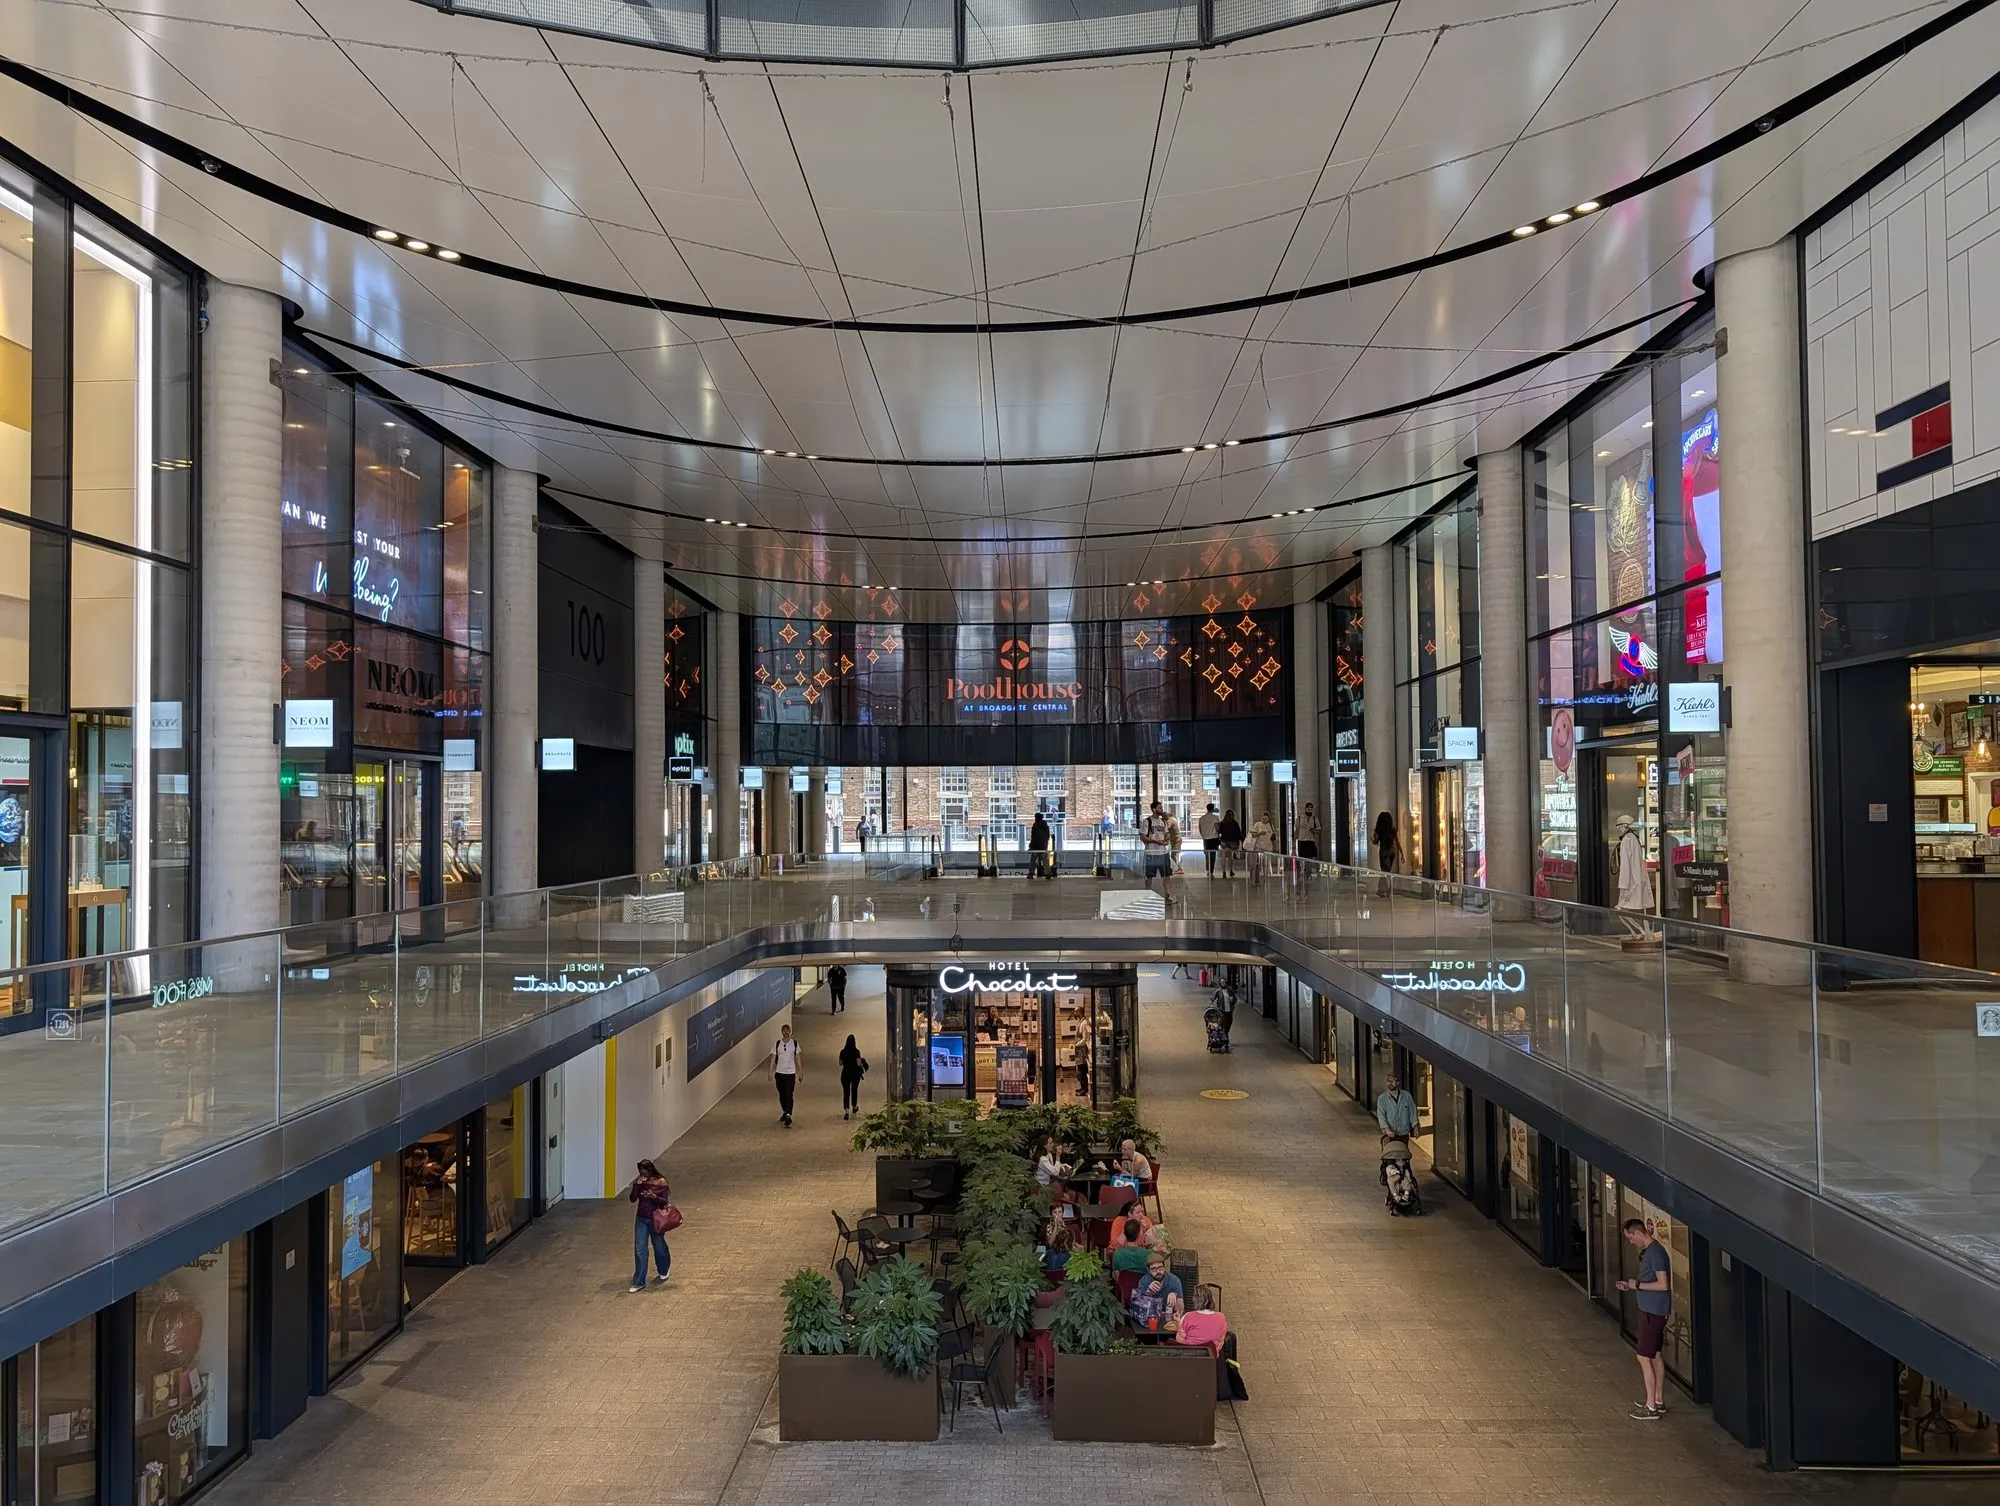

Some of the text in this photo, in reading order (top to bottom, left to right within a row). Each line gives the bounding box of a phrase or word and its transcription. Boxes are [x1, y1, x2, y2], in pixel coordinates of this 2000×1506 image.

[283, 500, 327, 529] AN WE
[375, 538, 400, 560] YOUR
[567, 600, 606, 667] 100
[367, 658, 435, 701] NEOM
[946, 676, 1082, 700] Poolhouse
[1673, 696, 1715, 714] Kiehl's
[290, 716, 330, 726] NEOM
[1336, 729, 1359, 748] REISS
[671, 765, 690, 773] optix
[1544, 792, 1577, 810] APOTHECA
[988, 962, 1030, 971] HOTEL
